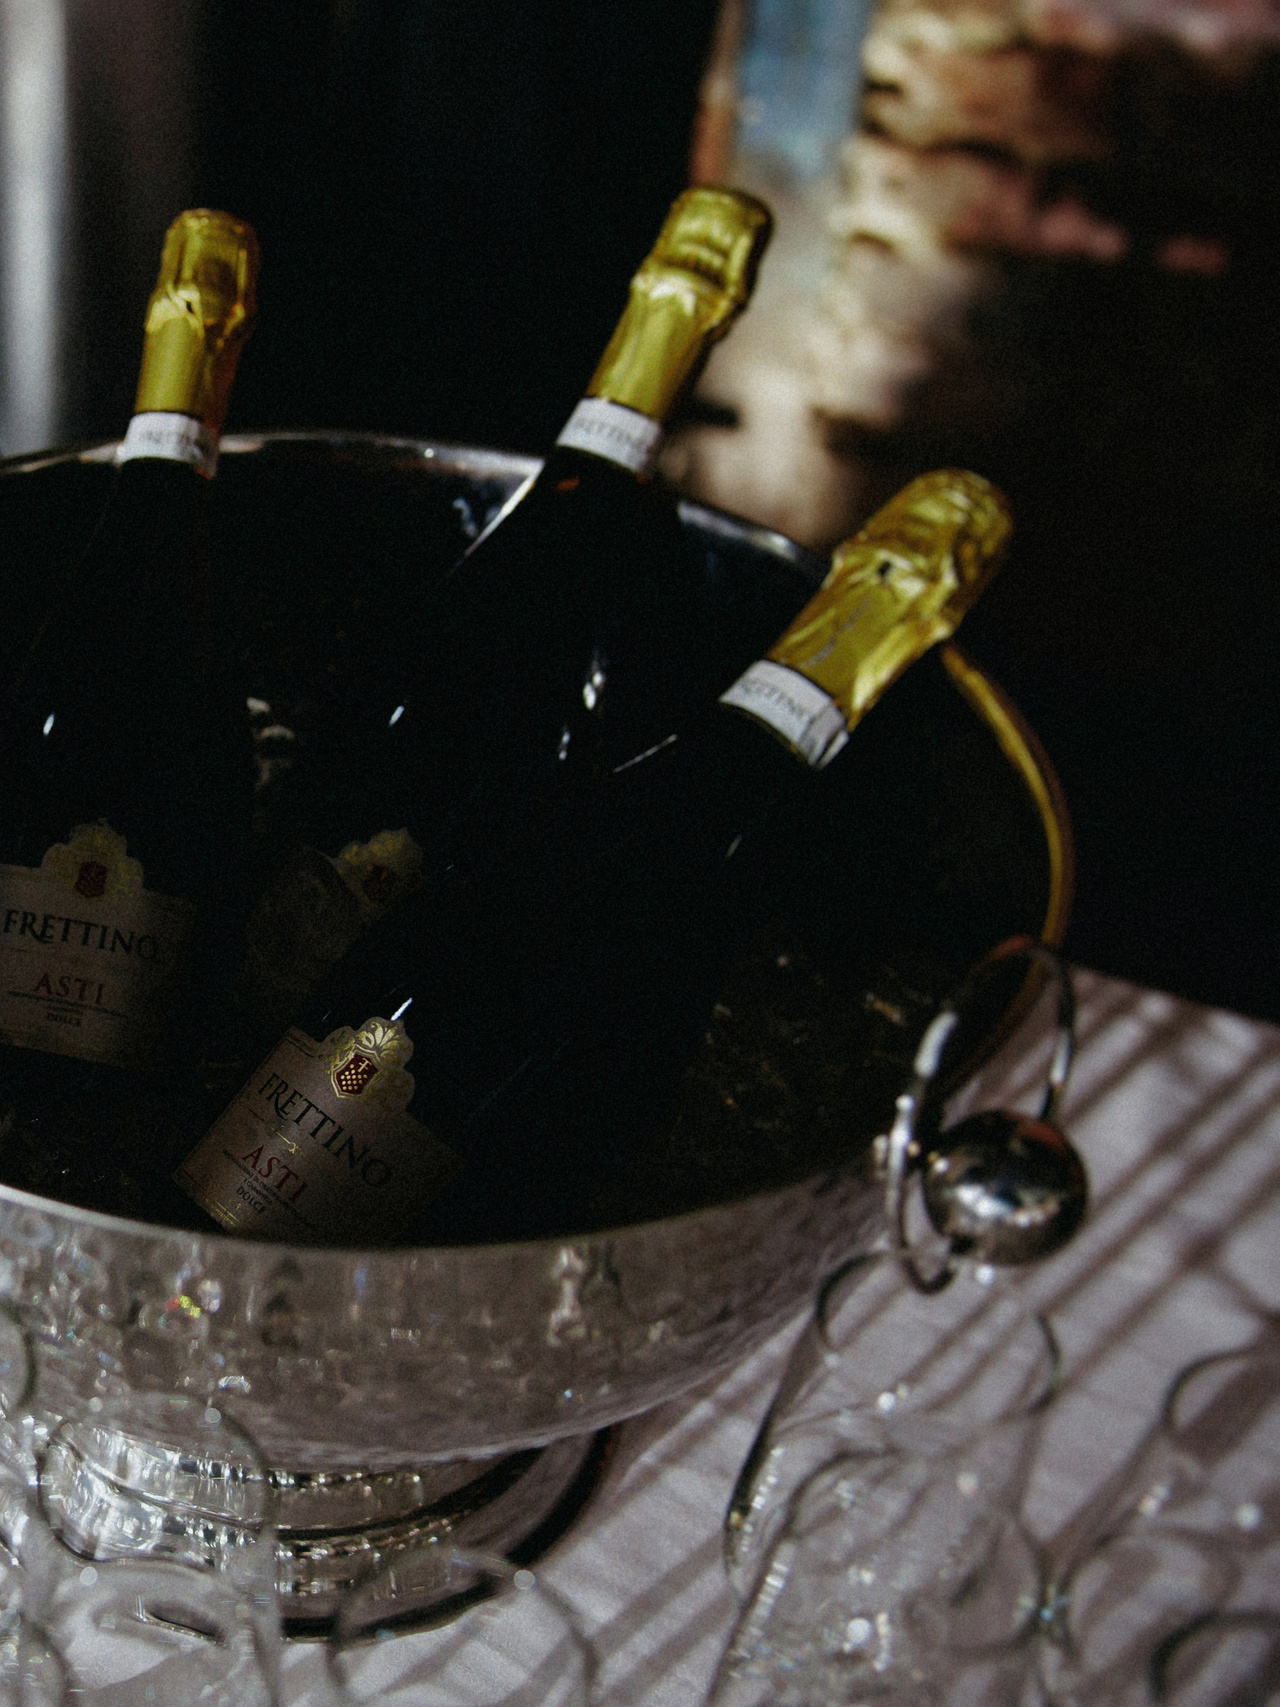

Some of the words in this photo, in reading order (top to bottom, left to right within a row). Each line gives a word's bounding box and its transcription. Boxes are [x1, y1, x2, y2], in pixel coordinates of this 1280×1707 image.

[3, 909, 157, 960] FRETTINO
[33, 972, 105, 1005] ASTI
[258, 1072, 392, 1188] FRETTINO
[236, 1186, 268, 1214] DOLCE
[241, 1145, 309, 1204] ASTI
